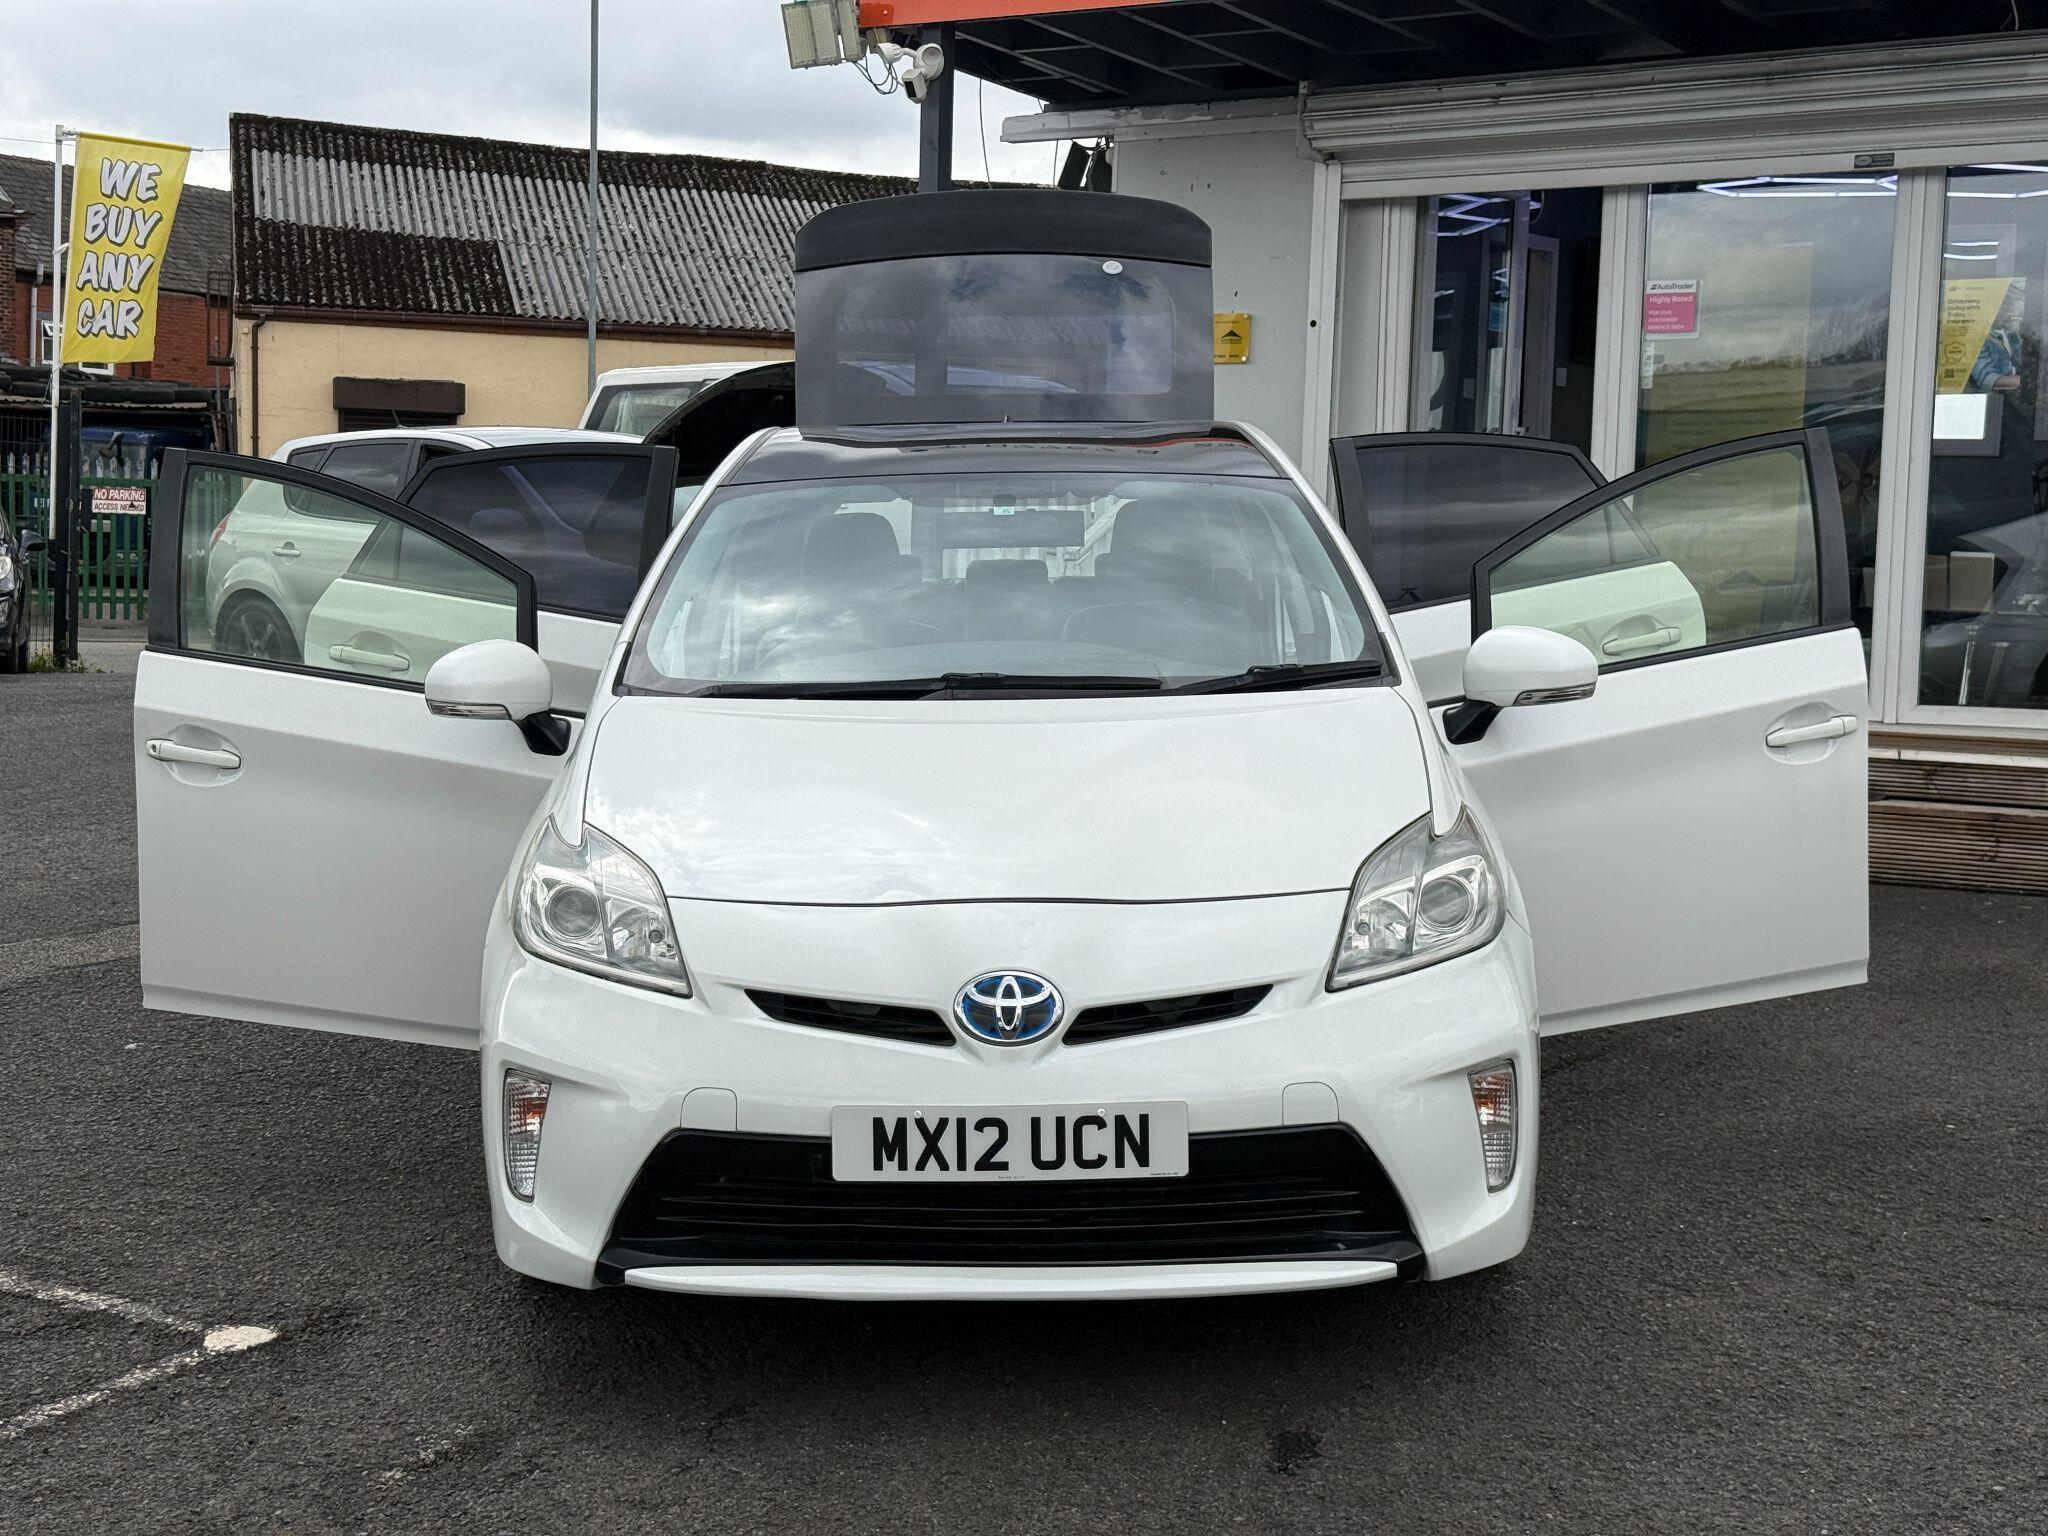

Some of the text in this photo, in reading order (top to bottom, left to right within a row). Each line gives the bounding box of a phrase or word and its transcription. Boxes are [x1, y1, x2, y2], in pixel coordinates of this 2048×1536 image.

[100, 158, 162, 203] WE
[83, 203, 162, 249] BUY
[75, 251, 155, 293] ANY
[76, 298, 144, 338] CAR
[94, 488, 145, 501] NO PARKING
[94, 502, 118, 511] ACCESS
[872, 1113, 1151, 1172] MX12 UCN
